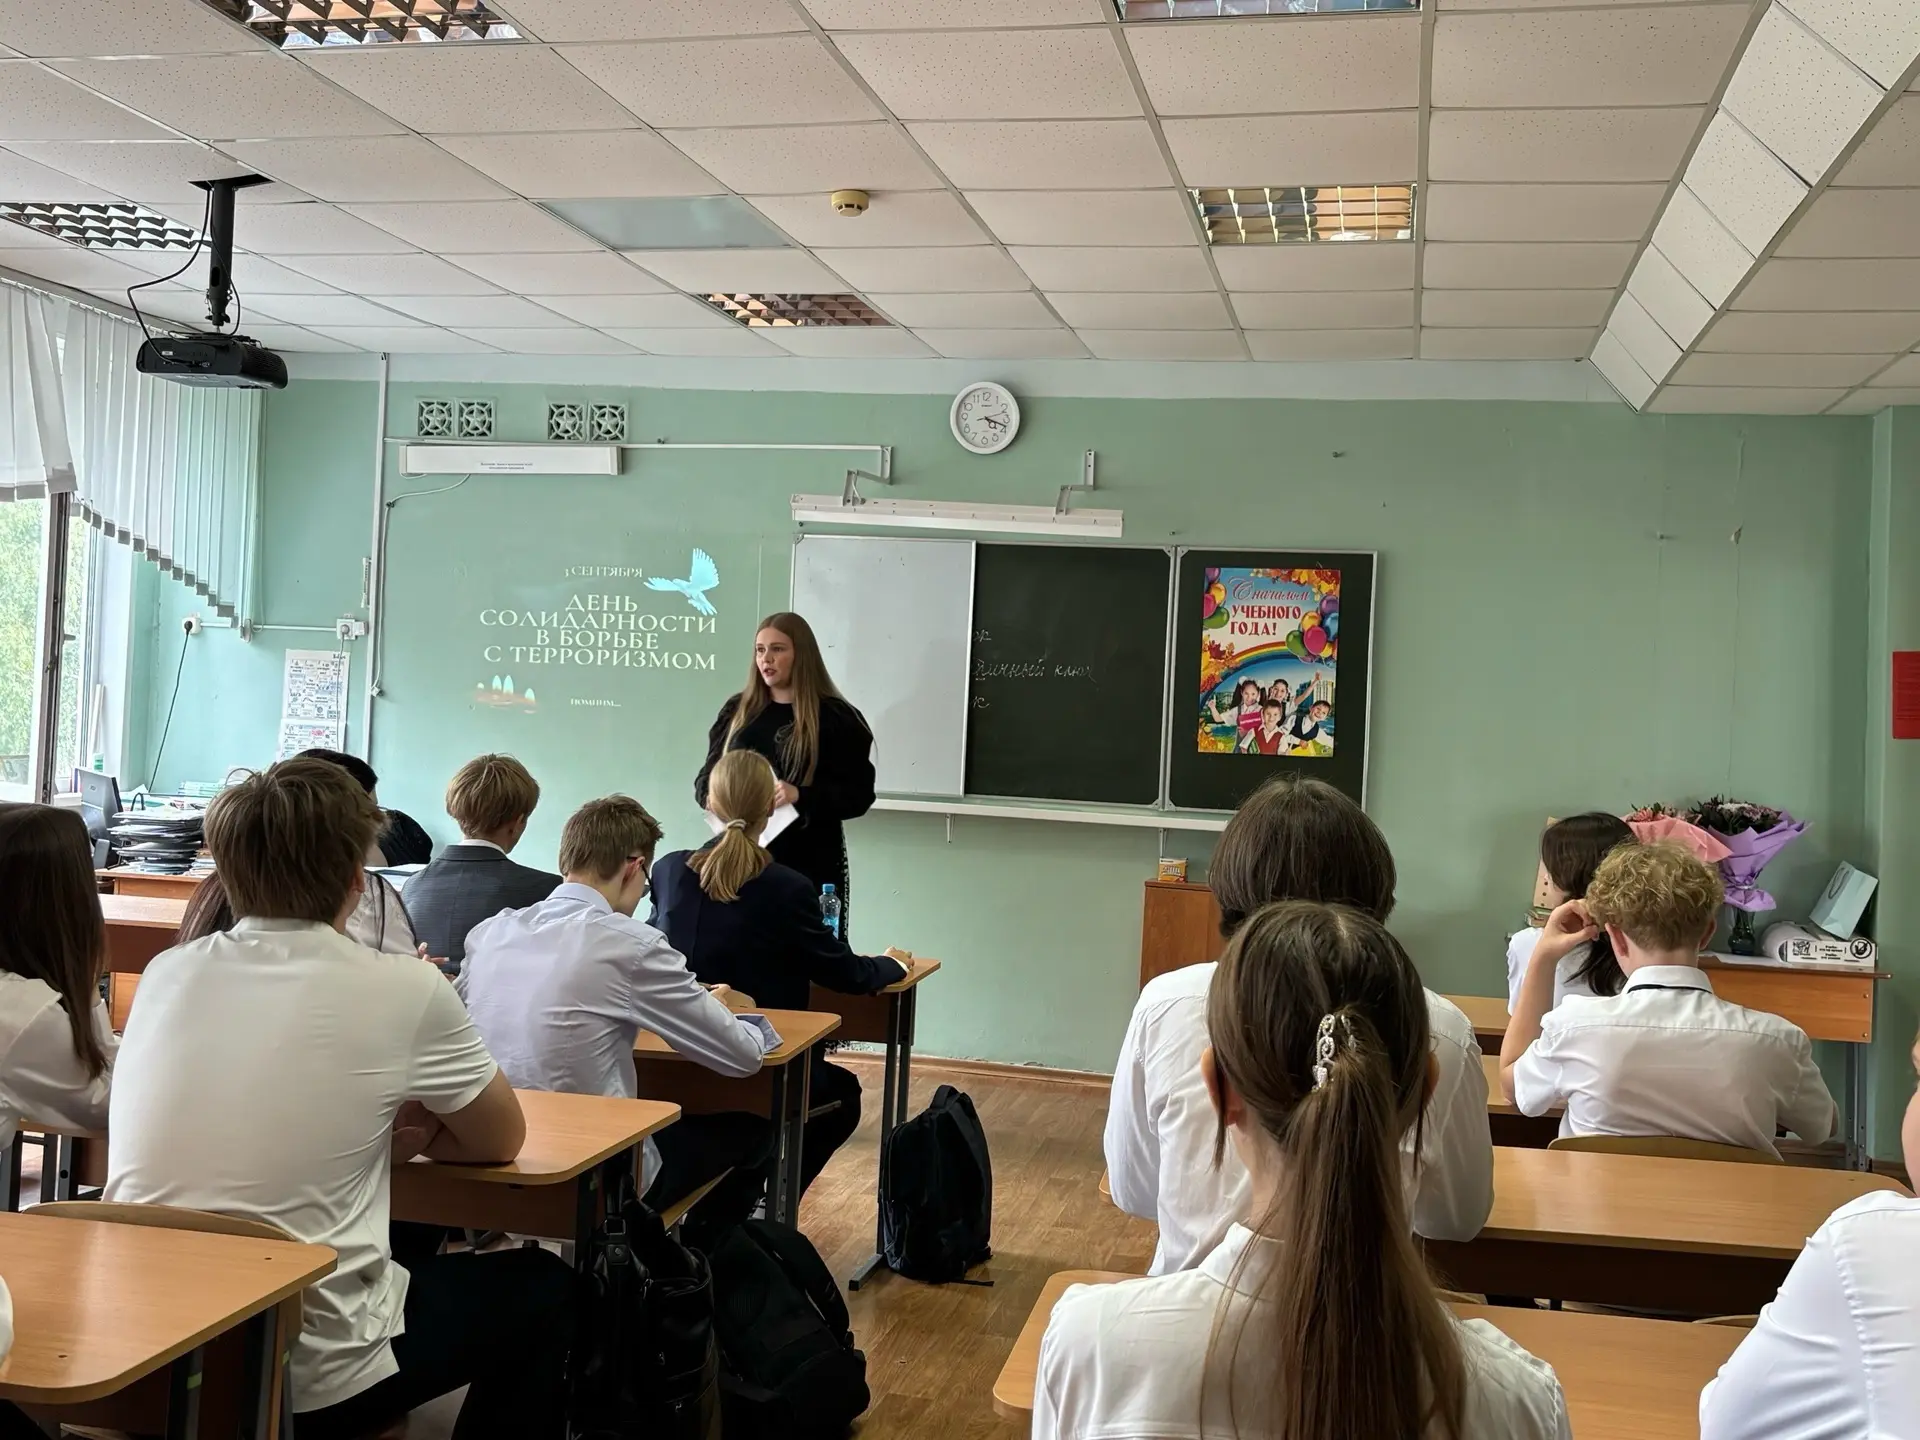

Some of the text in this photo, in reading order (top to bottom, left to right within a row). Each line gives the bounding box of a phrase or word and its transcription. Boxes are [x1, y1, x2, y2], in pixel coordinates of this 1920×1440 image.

[983, 392, 991, 402] 12
[964, 403, 973, 412] 10
[1001, 404, 1008, 414] 2
[962, 413, 969, 421] 9
[1003, 415, 1010, 424] 3
[964, 424, 970, 434] 8
[972, 433, 977, 441] 7
[981, 437, 988, 445] 6
[992, 434, 999, 443] 5
[571, 566, 643, 578] СЕНТЯБРЯ
[1228, 576, 1255, 600] С
[565, 594, 638, 613] ДЕНЬ
[1231, 604, 1302, 620] УЧЕБНОГО
[479, 608, 717, 634] СОЛИДАРНОСТИ
[1230, 621, 1277, 636] ГОДА!
[536, 629, 659, 650] В БОРЬБЕ
[483, 645, 716, 671] С ТЕРРОРИЗМОМ
